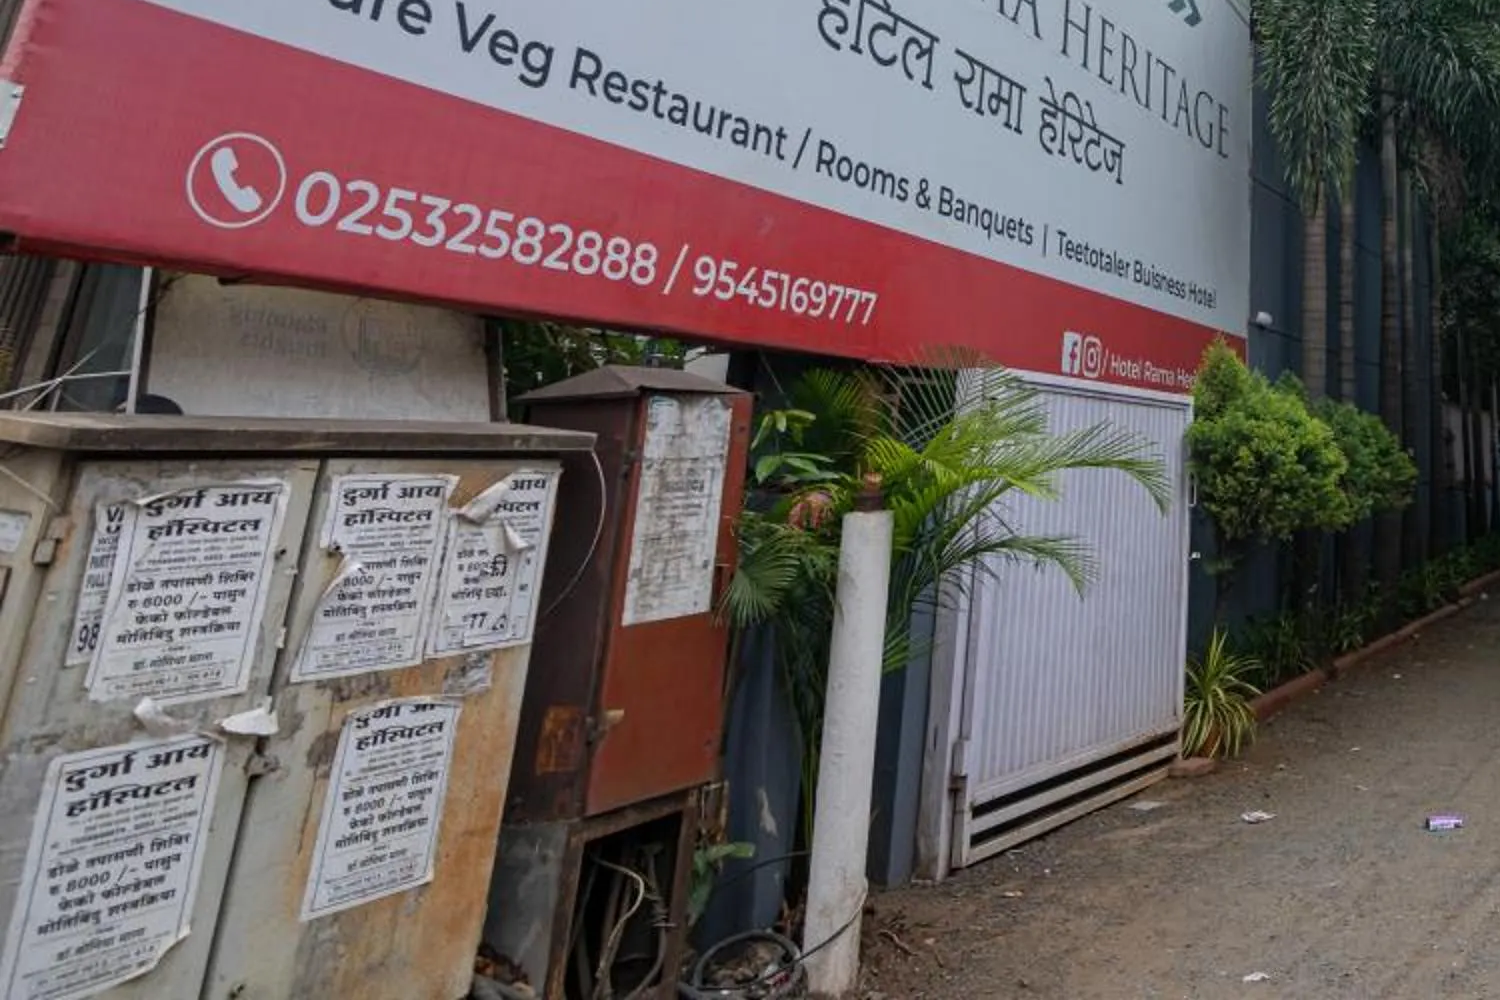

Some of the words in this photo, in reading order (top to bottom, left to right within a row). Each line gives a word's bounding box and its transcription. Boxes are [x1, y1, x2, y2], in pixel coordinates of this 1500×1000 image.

[953, 48, 1027, 135] रामा
[1038, 76, 1126, 185] हेरिटेज
[455, 1, 553, 89] Veg
[569, 49, 787, 161] Restaurant
[815, 139, 909, 204] Rooms
[916, 178, 933, 211] &
[938, 185, 1034, 247] Banquets
[1056, 229, 1130, 278] Teetotaler
[294, 170, 658, 286] 02532582888
[694, 254, 878, 327] 9545169777
[1110, 353, 1142, 381] Hotel
[1144, 360, 1176, 385] Rama
[1178, 366, 1199, 389] Heri
[343, 482, 394, 506] दुर्गा
[397, 485, 445, 499] आय
[509, 478, 548, 492] आय
[142, 489, 206, 517] दुर्गा
[215, 491, 275, 508] आय
[343, 508, 434, 527] हॉस्पिटल
[148, 518, 262, 541] हॉस्पिटल
[355, 720, 446, 751] हॉस्पिटल
[65, 751, 140, 793] दुर्गा
[146, 743, 212, 769] आय
[66, 774, 199, 818] हॉस्पिटल
